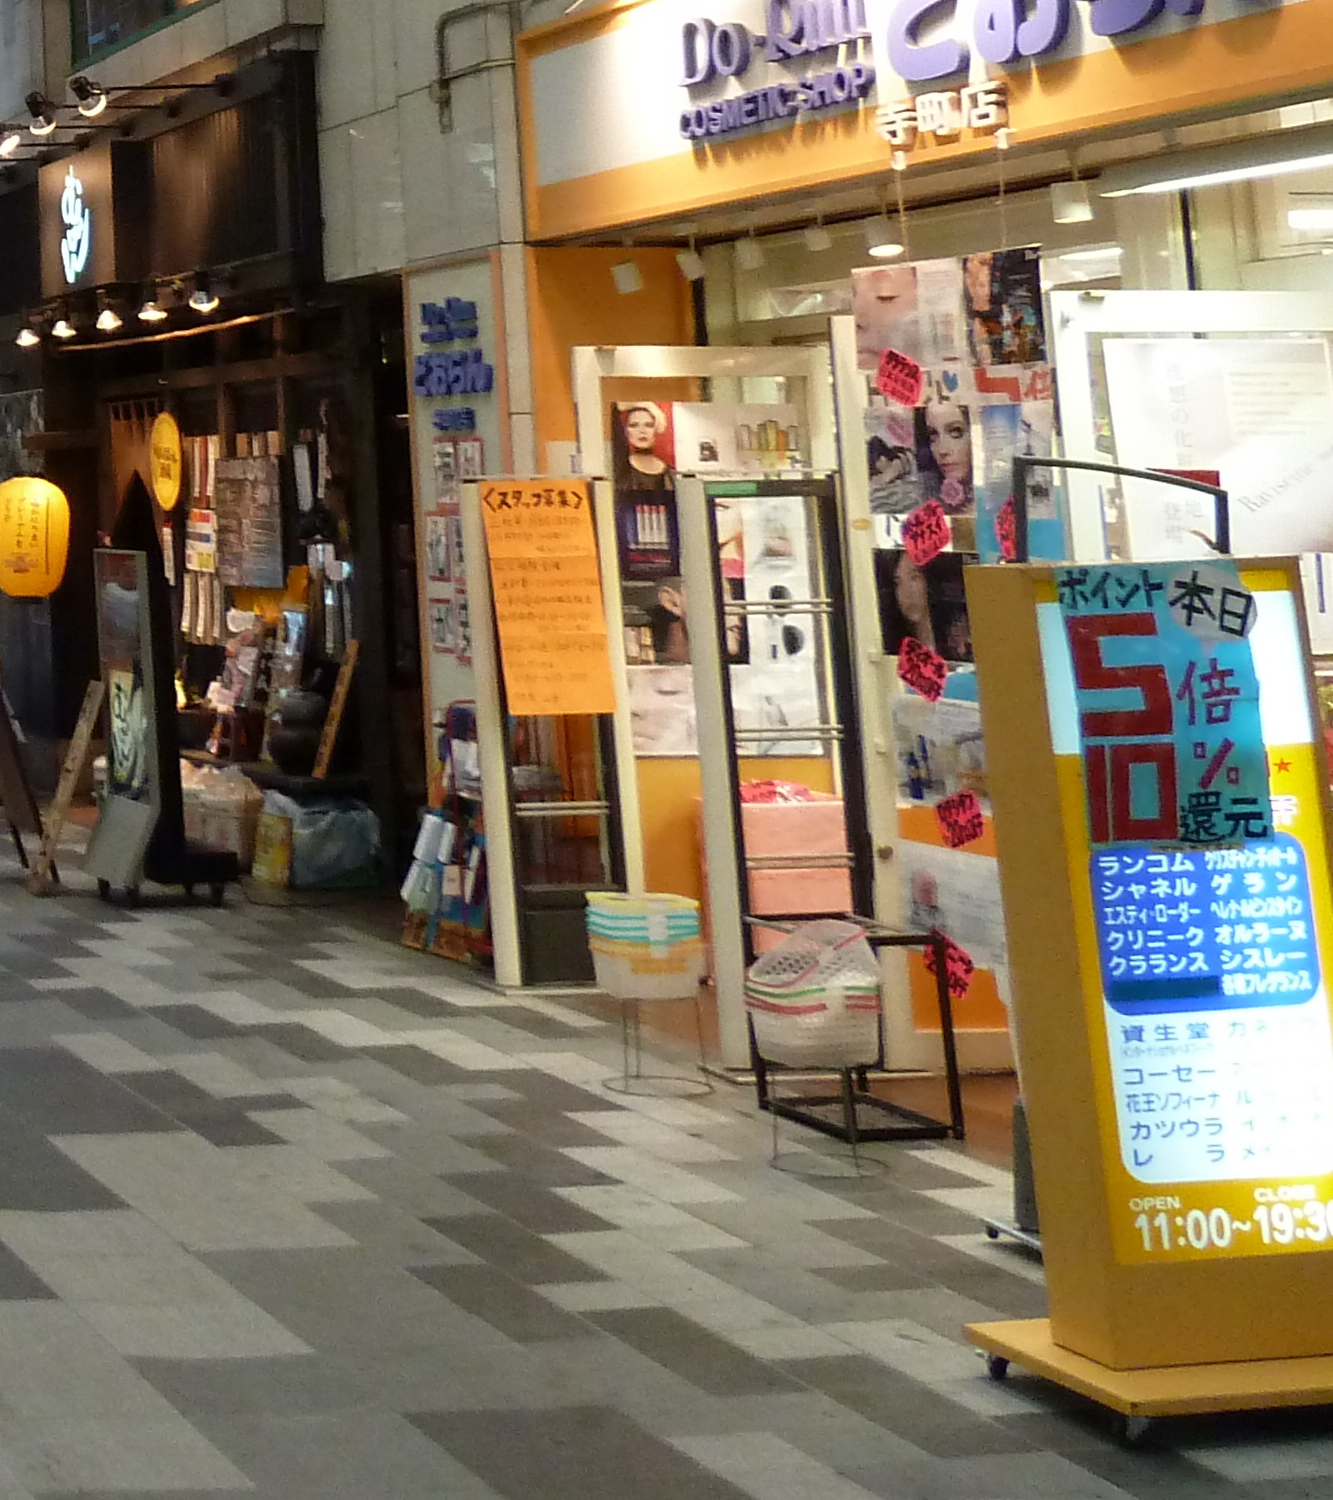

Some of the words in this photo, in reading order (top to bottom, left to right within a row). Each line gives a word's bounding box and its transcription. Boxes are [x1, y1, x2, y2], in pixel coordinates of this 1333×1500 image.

[876, 80, 1008, 147] 寺町店
[1058, 569, 1164, 610] ポイント
[1169, 570, 1254, 637] 本日
[1179, 791, 1269, 844] 還元
[1098, 853, 1195, 877] ランコム
[1101, 877, 1197, 901] シャネル
[1210, 871, 1298, 896] ゲラン
[1106, 926, 1205, 951] クリニーク
[1214, 920, 1307, 945] オルラーヌ
[1108, 951, 1209, 976] クラランス
[1219, 946, 1307, 971] シスレー
[1120, 1022, 1211, 1044] 資生堂
[1122, 1064, 1216, 1086] コーセー
[1124, 1092, 1221, 1114] 花王ソフィーナ
[1129, 1118, 1224, 1141] カツウラ
[1129, 1195, 1181, 1211] OPEN
